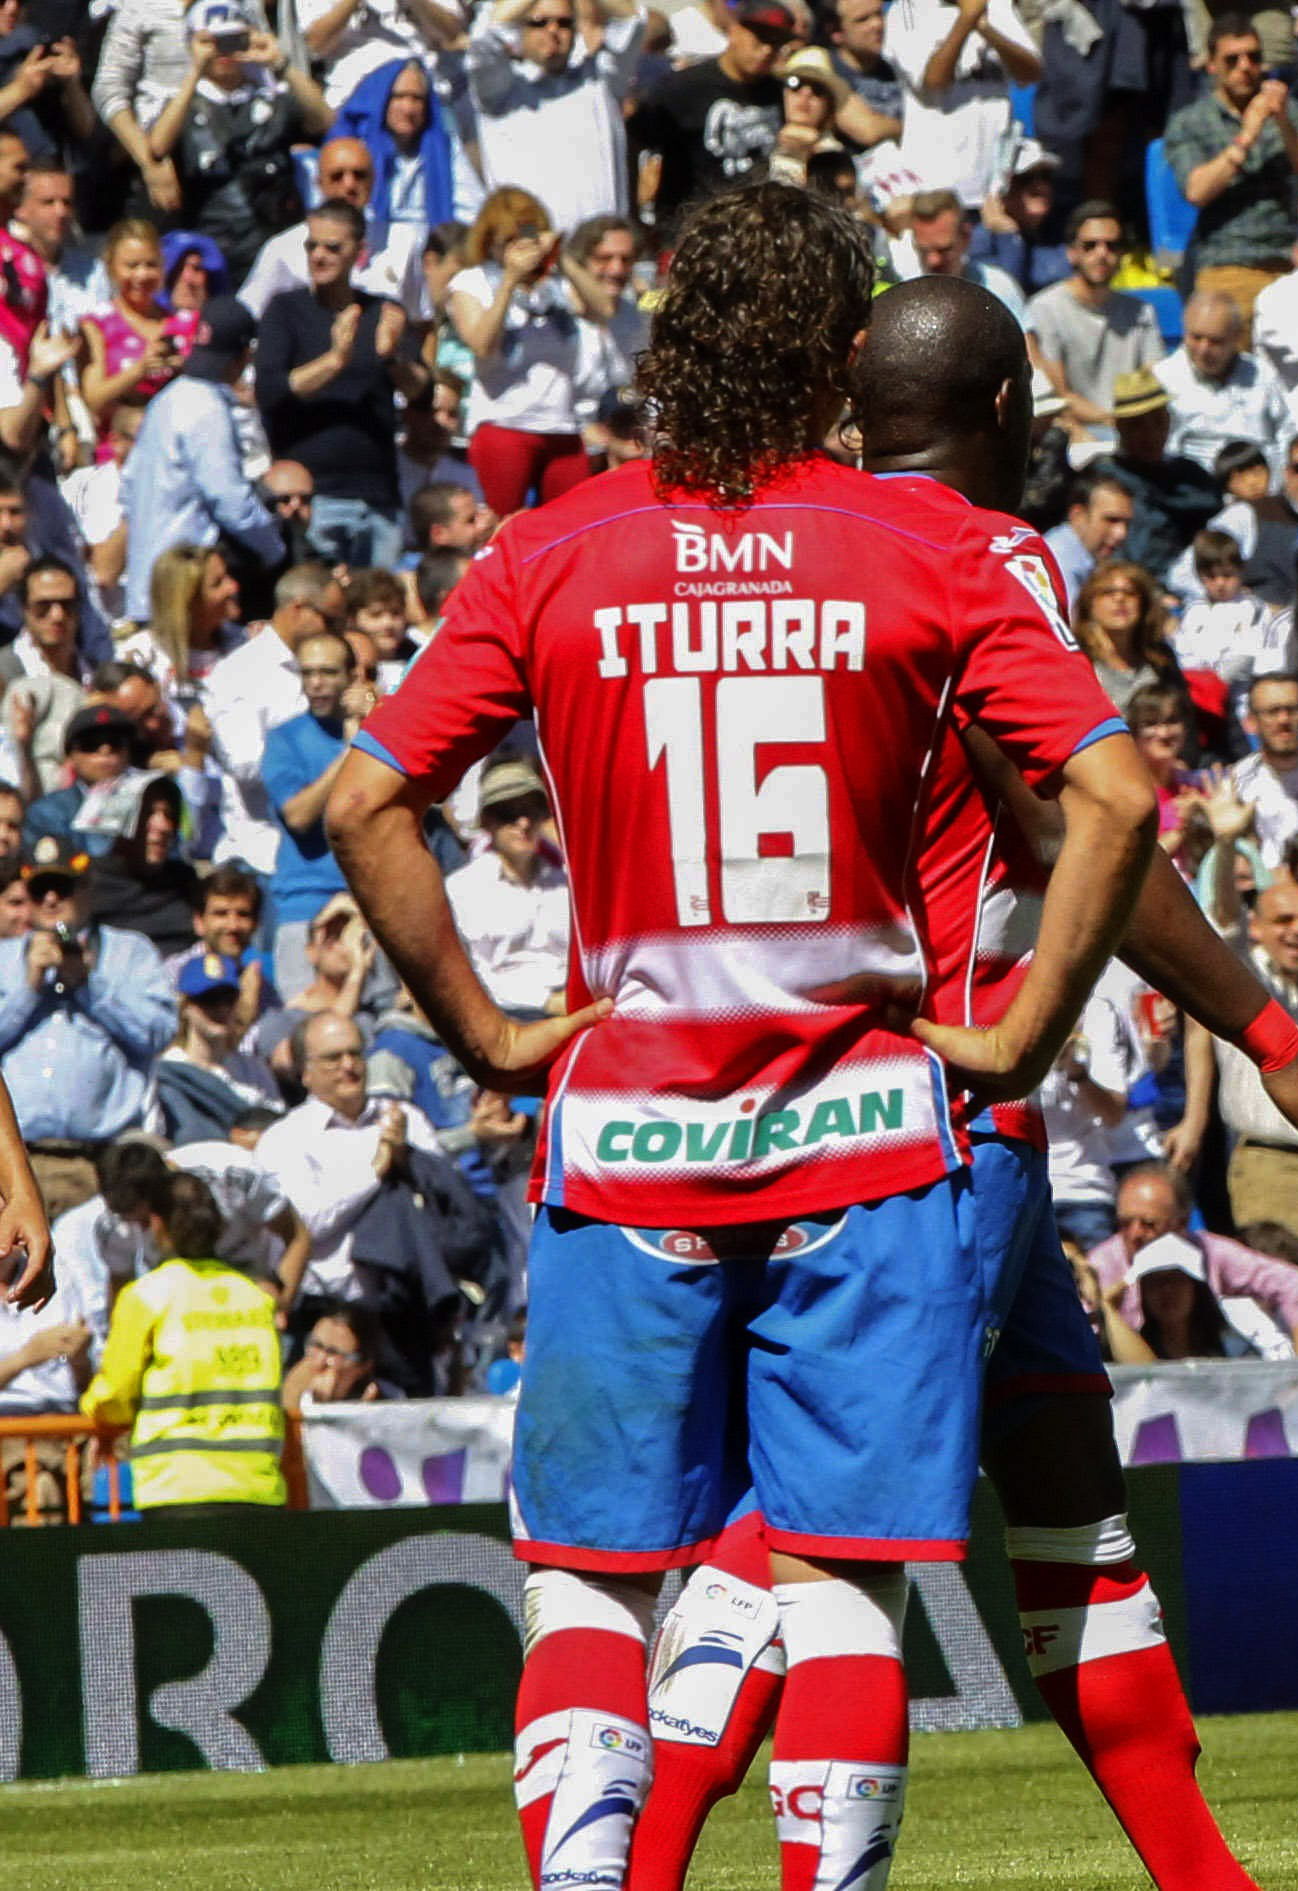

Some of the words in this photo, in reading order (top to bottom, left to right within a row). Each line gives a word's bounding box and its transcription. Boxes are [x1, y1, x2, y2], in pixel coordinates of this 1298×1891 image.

[671, 519, 793, 572] BMN
[674, 580, 793, 597] CAJAGRANADA
[593, 599, 866, 679] ITURRA
[642, 675, 831, 927] 16
